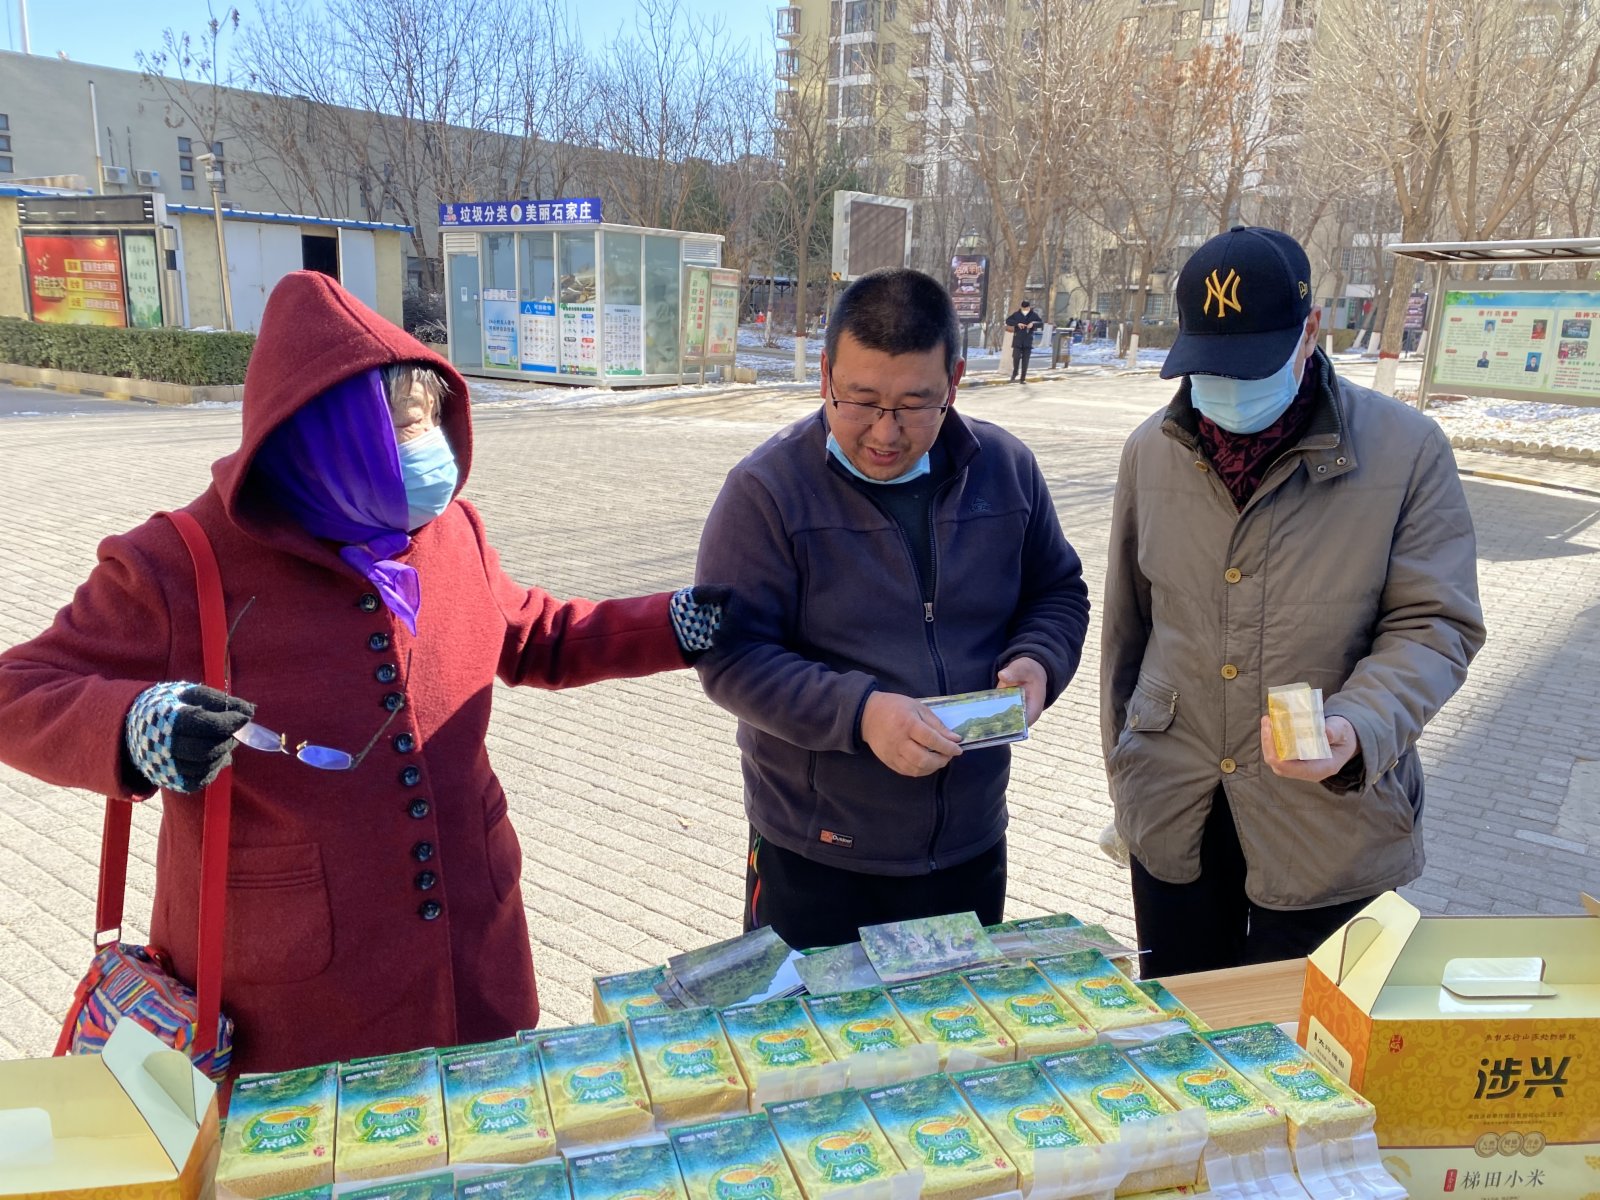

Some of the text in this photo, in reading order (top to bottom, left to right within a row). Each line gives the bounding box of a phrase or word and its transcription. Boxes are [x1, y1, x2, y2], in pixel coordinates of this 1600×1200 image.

[460, 202, 592, 223] 垃圾分类 美丽石家庄
[1203, 268, 1242, 318] NY
[1473, 1056, 1572, 1100] 涉兴
[1460, 1168, 1546, 1190] 梯田小米
